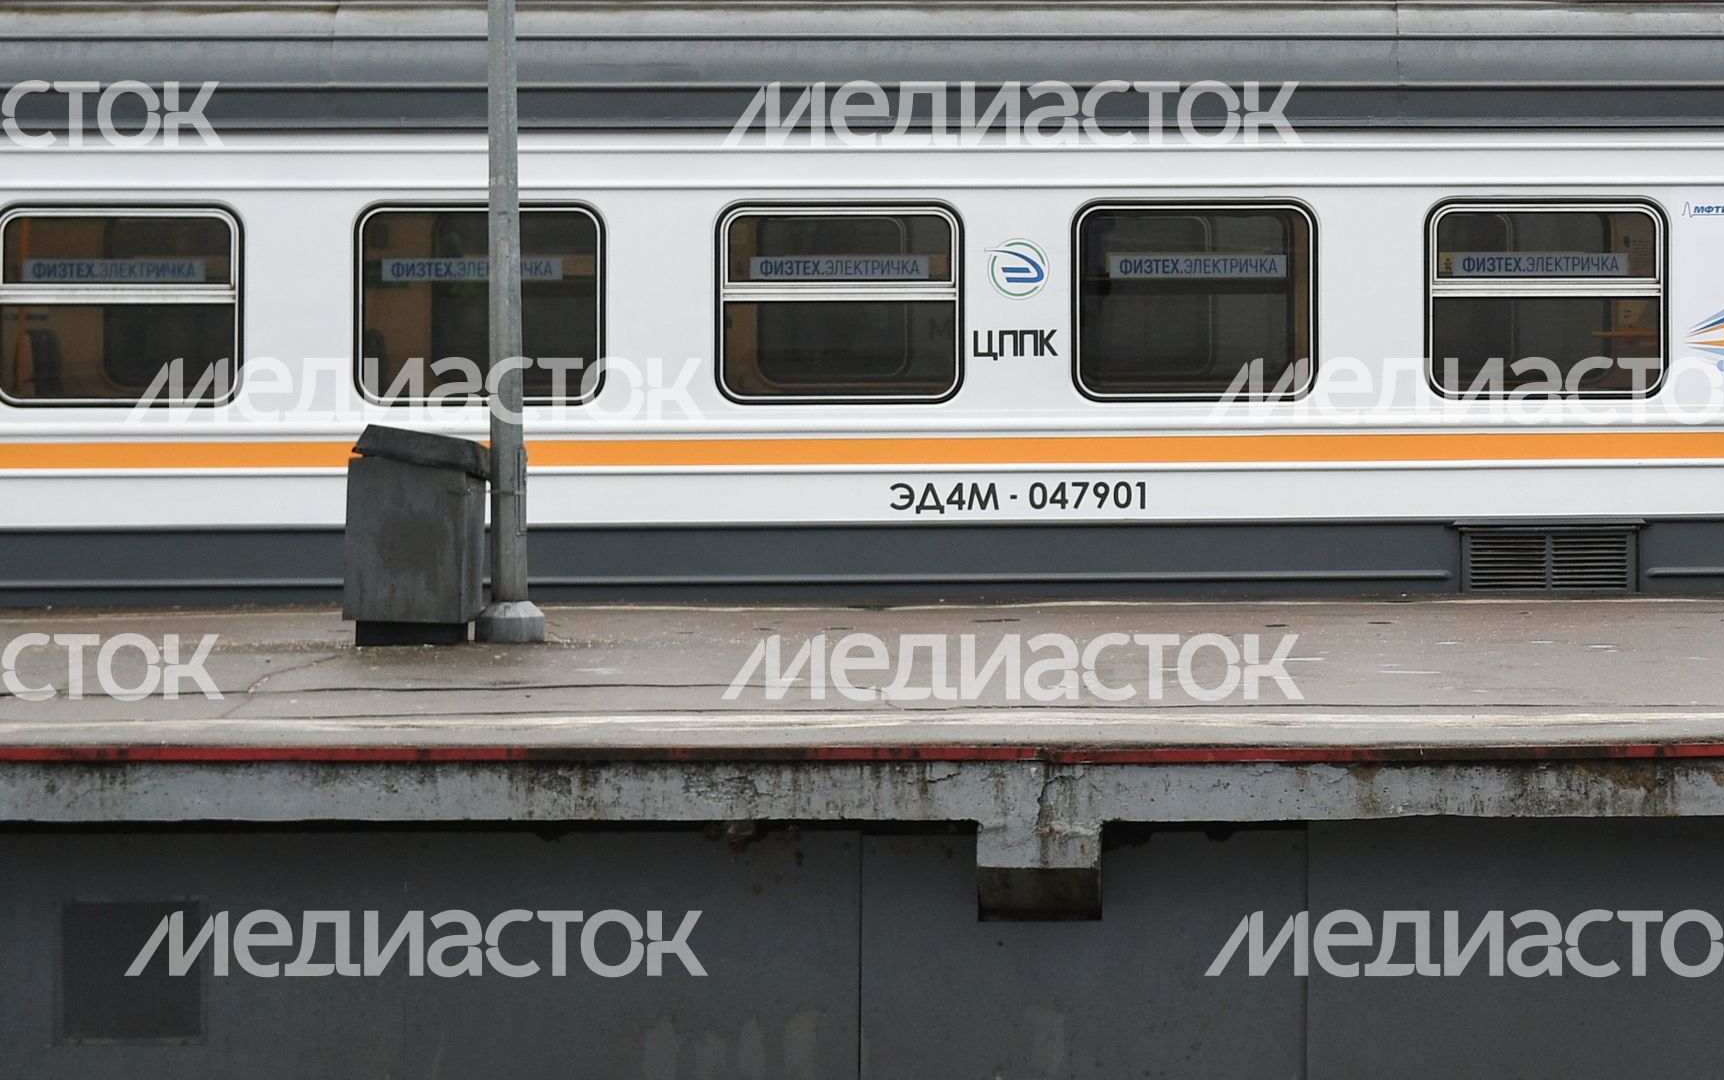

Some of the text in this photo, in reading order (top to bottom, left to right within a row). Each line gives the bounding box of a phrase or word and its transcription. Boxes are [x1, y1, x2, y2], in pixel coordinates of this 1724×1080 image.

[32, 261, 197, 279] ФИЗТЕХ.ЭЛЕКТРИЧКА
[390, 261, 553, 278] ФИЗТЕХ.ЭЛЕЧКА
[759, 259, 920, 276] ФИЗТЕХ.ЭЛЕКТРИЧКА
[1119, 257, 1278, 275] ФИЗТЕХ.ЭЛЕКТРИЧКА
[1462, 255, 1620, 273] ФИЗТЕХ.ЭЛЕКТРИЧКА
[972, 329, 1058, 361] ЦППК
[889, 482, 1000, 515] ЭД4М
[1028, 481, 1147, 510] 047901
